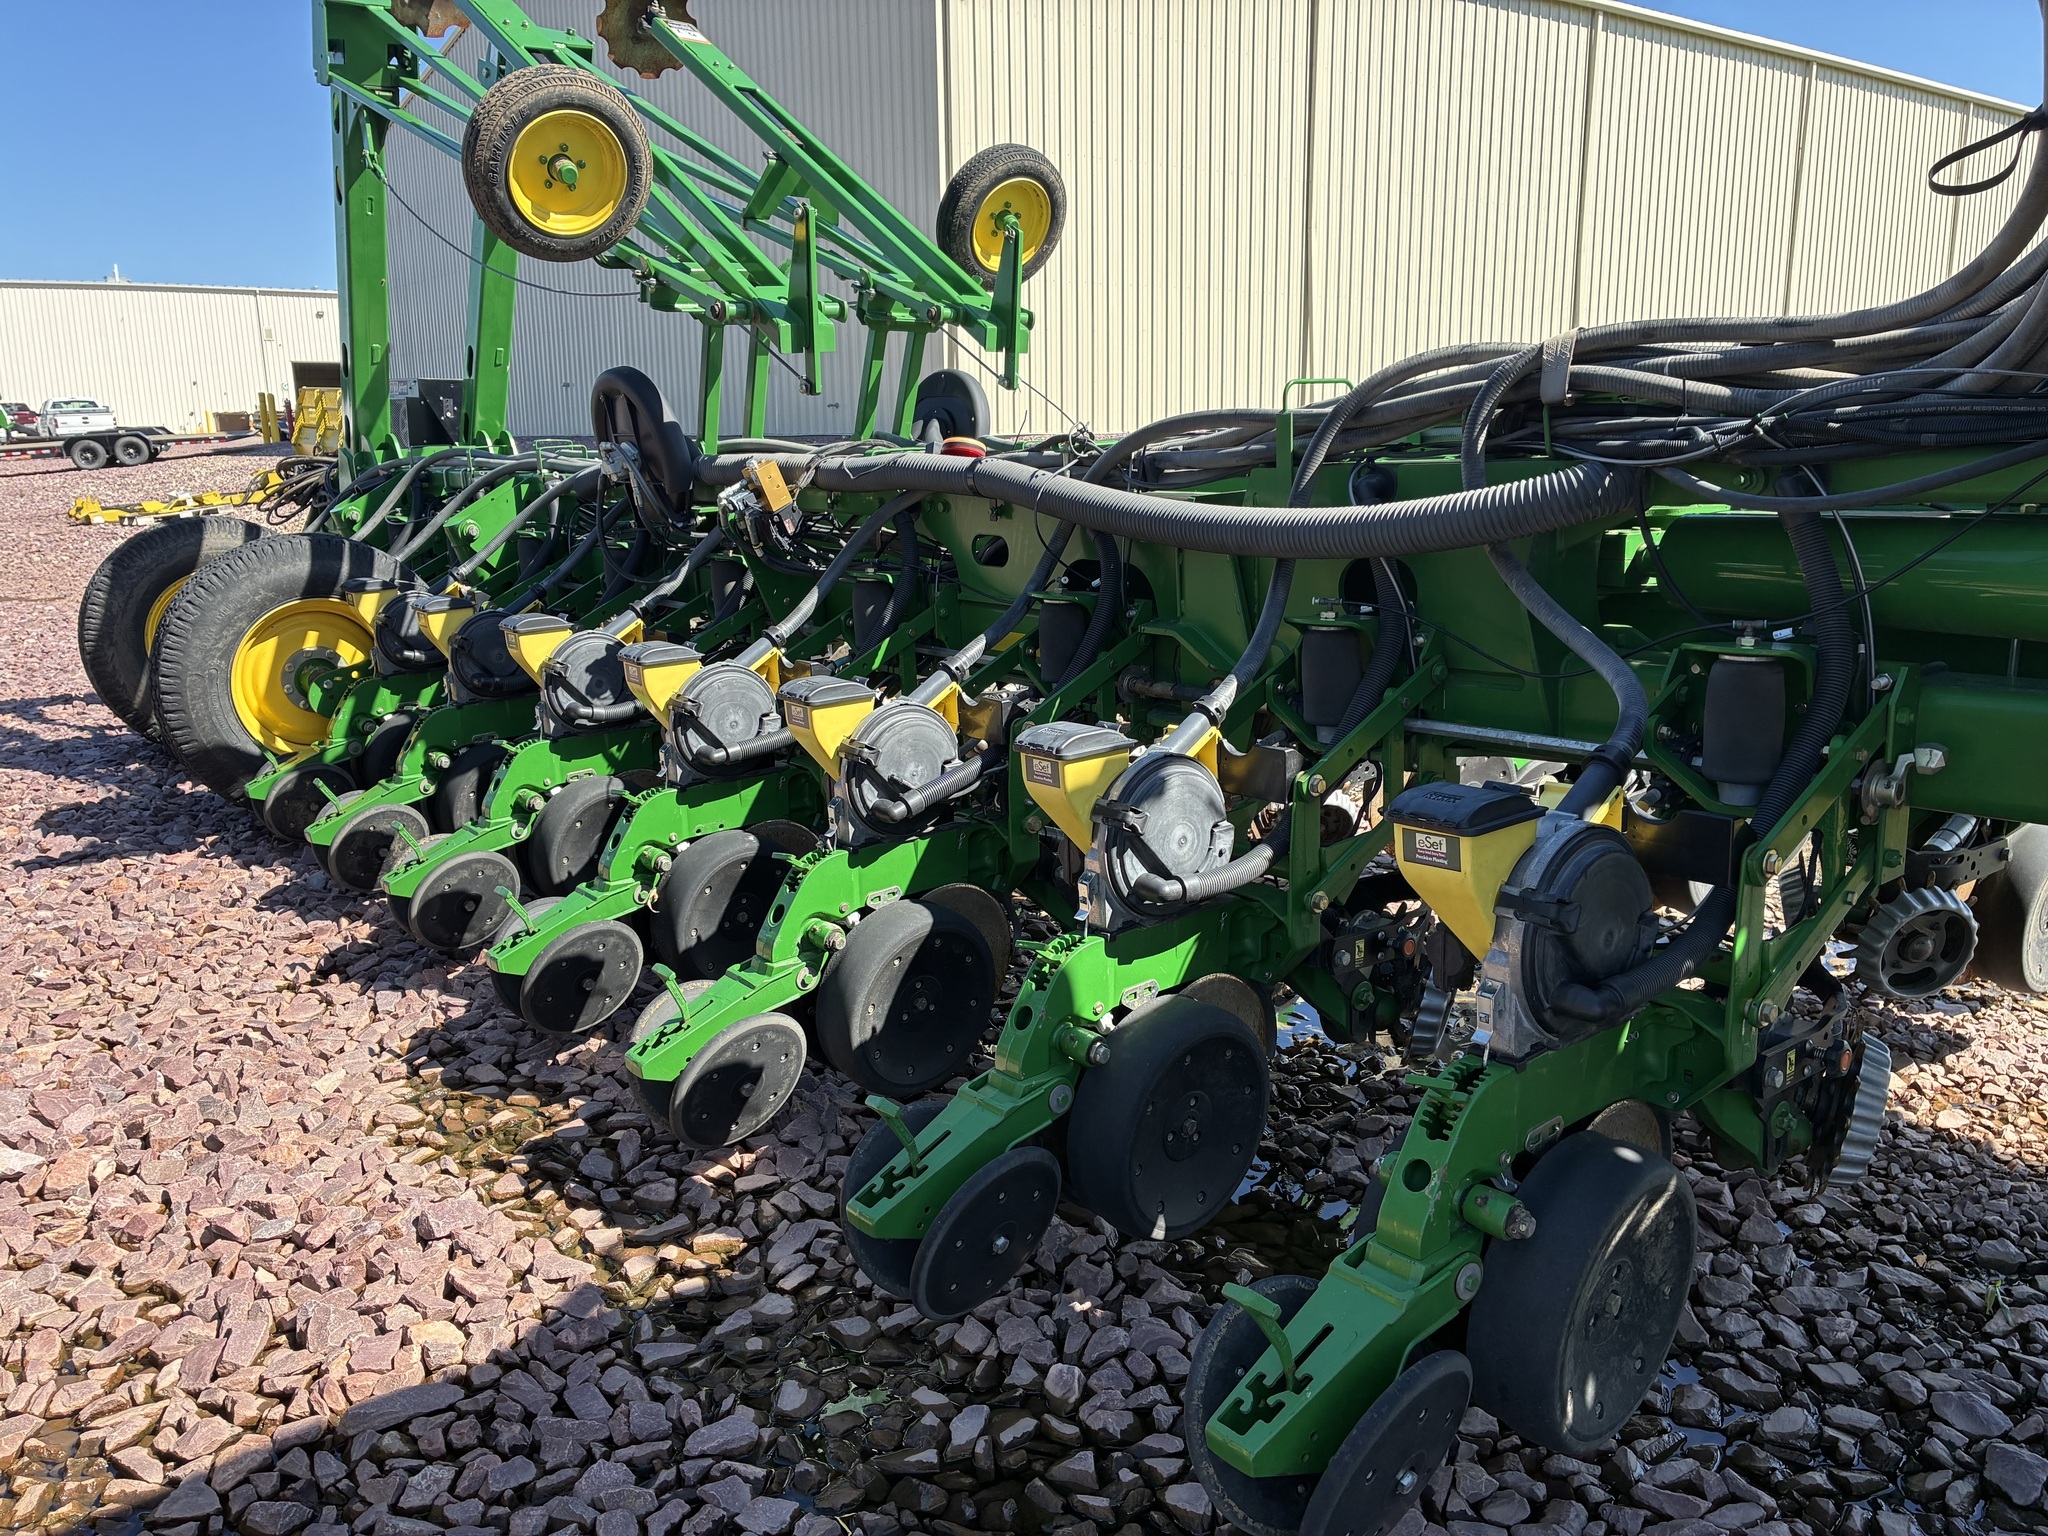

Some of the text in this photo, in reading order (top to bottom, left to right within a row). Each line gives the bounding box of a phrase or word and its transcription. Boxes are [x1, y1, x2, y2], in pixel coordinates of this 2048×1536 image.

[488, 104, 531, 187] CARLISLE
[589, 152, 644, 249] SPORT TRAIL
[1034, 761, 1050, 772] eSet
[1418, 836, 1443, 850] eSet
[1433, 857, 1449, 865] Planting
